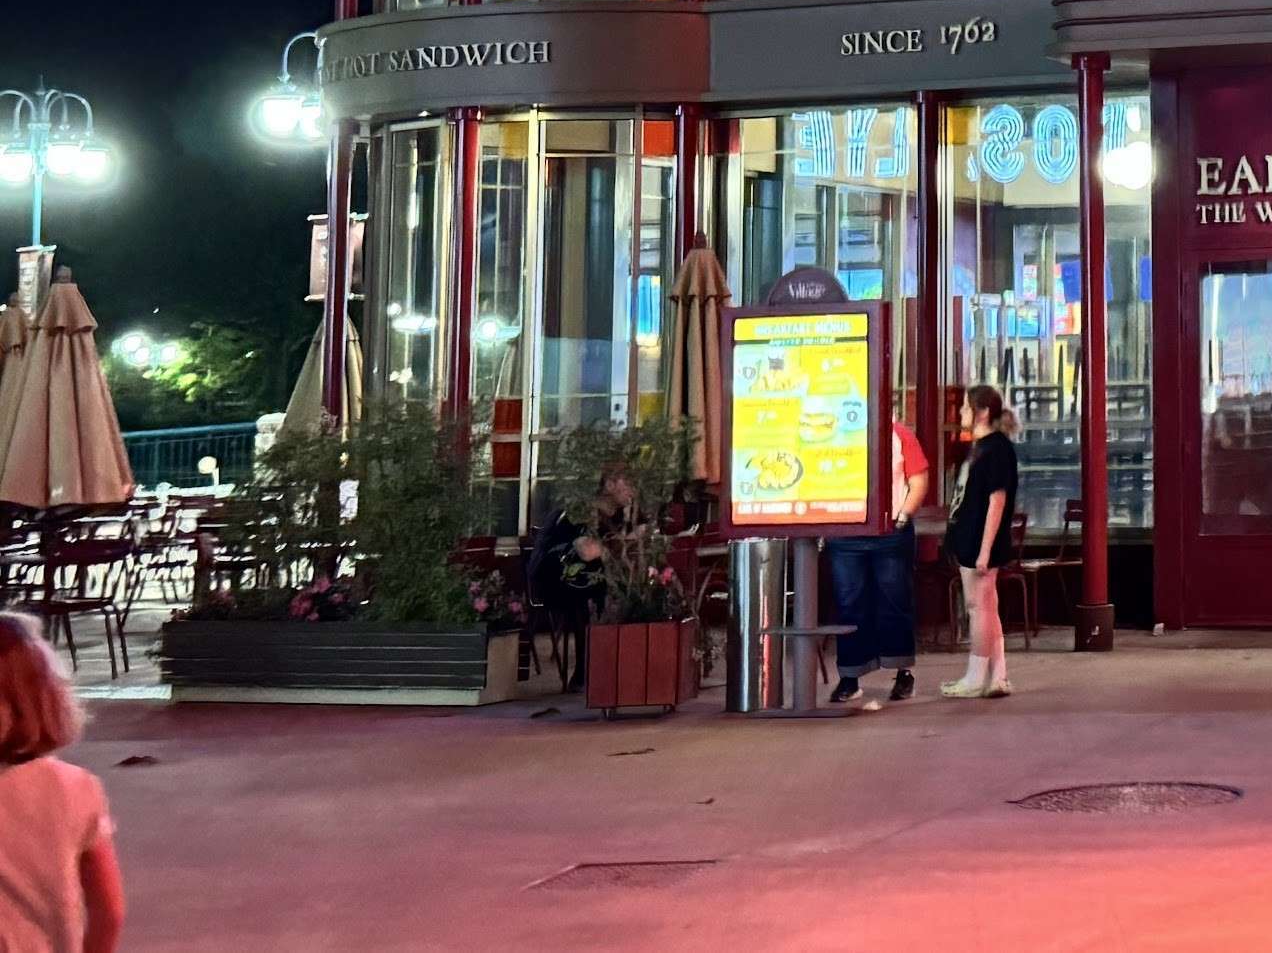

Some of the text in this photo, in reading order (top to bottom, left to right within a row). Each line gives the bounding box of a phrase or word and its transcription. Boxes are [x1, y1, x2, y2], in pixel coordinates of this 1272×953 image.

[840, 18, 997, 56] SINCE 1762
[388, 40, 551, 72] SANDWICH
[1195, 201, 1247, 225] THE
